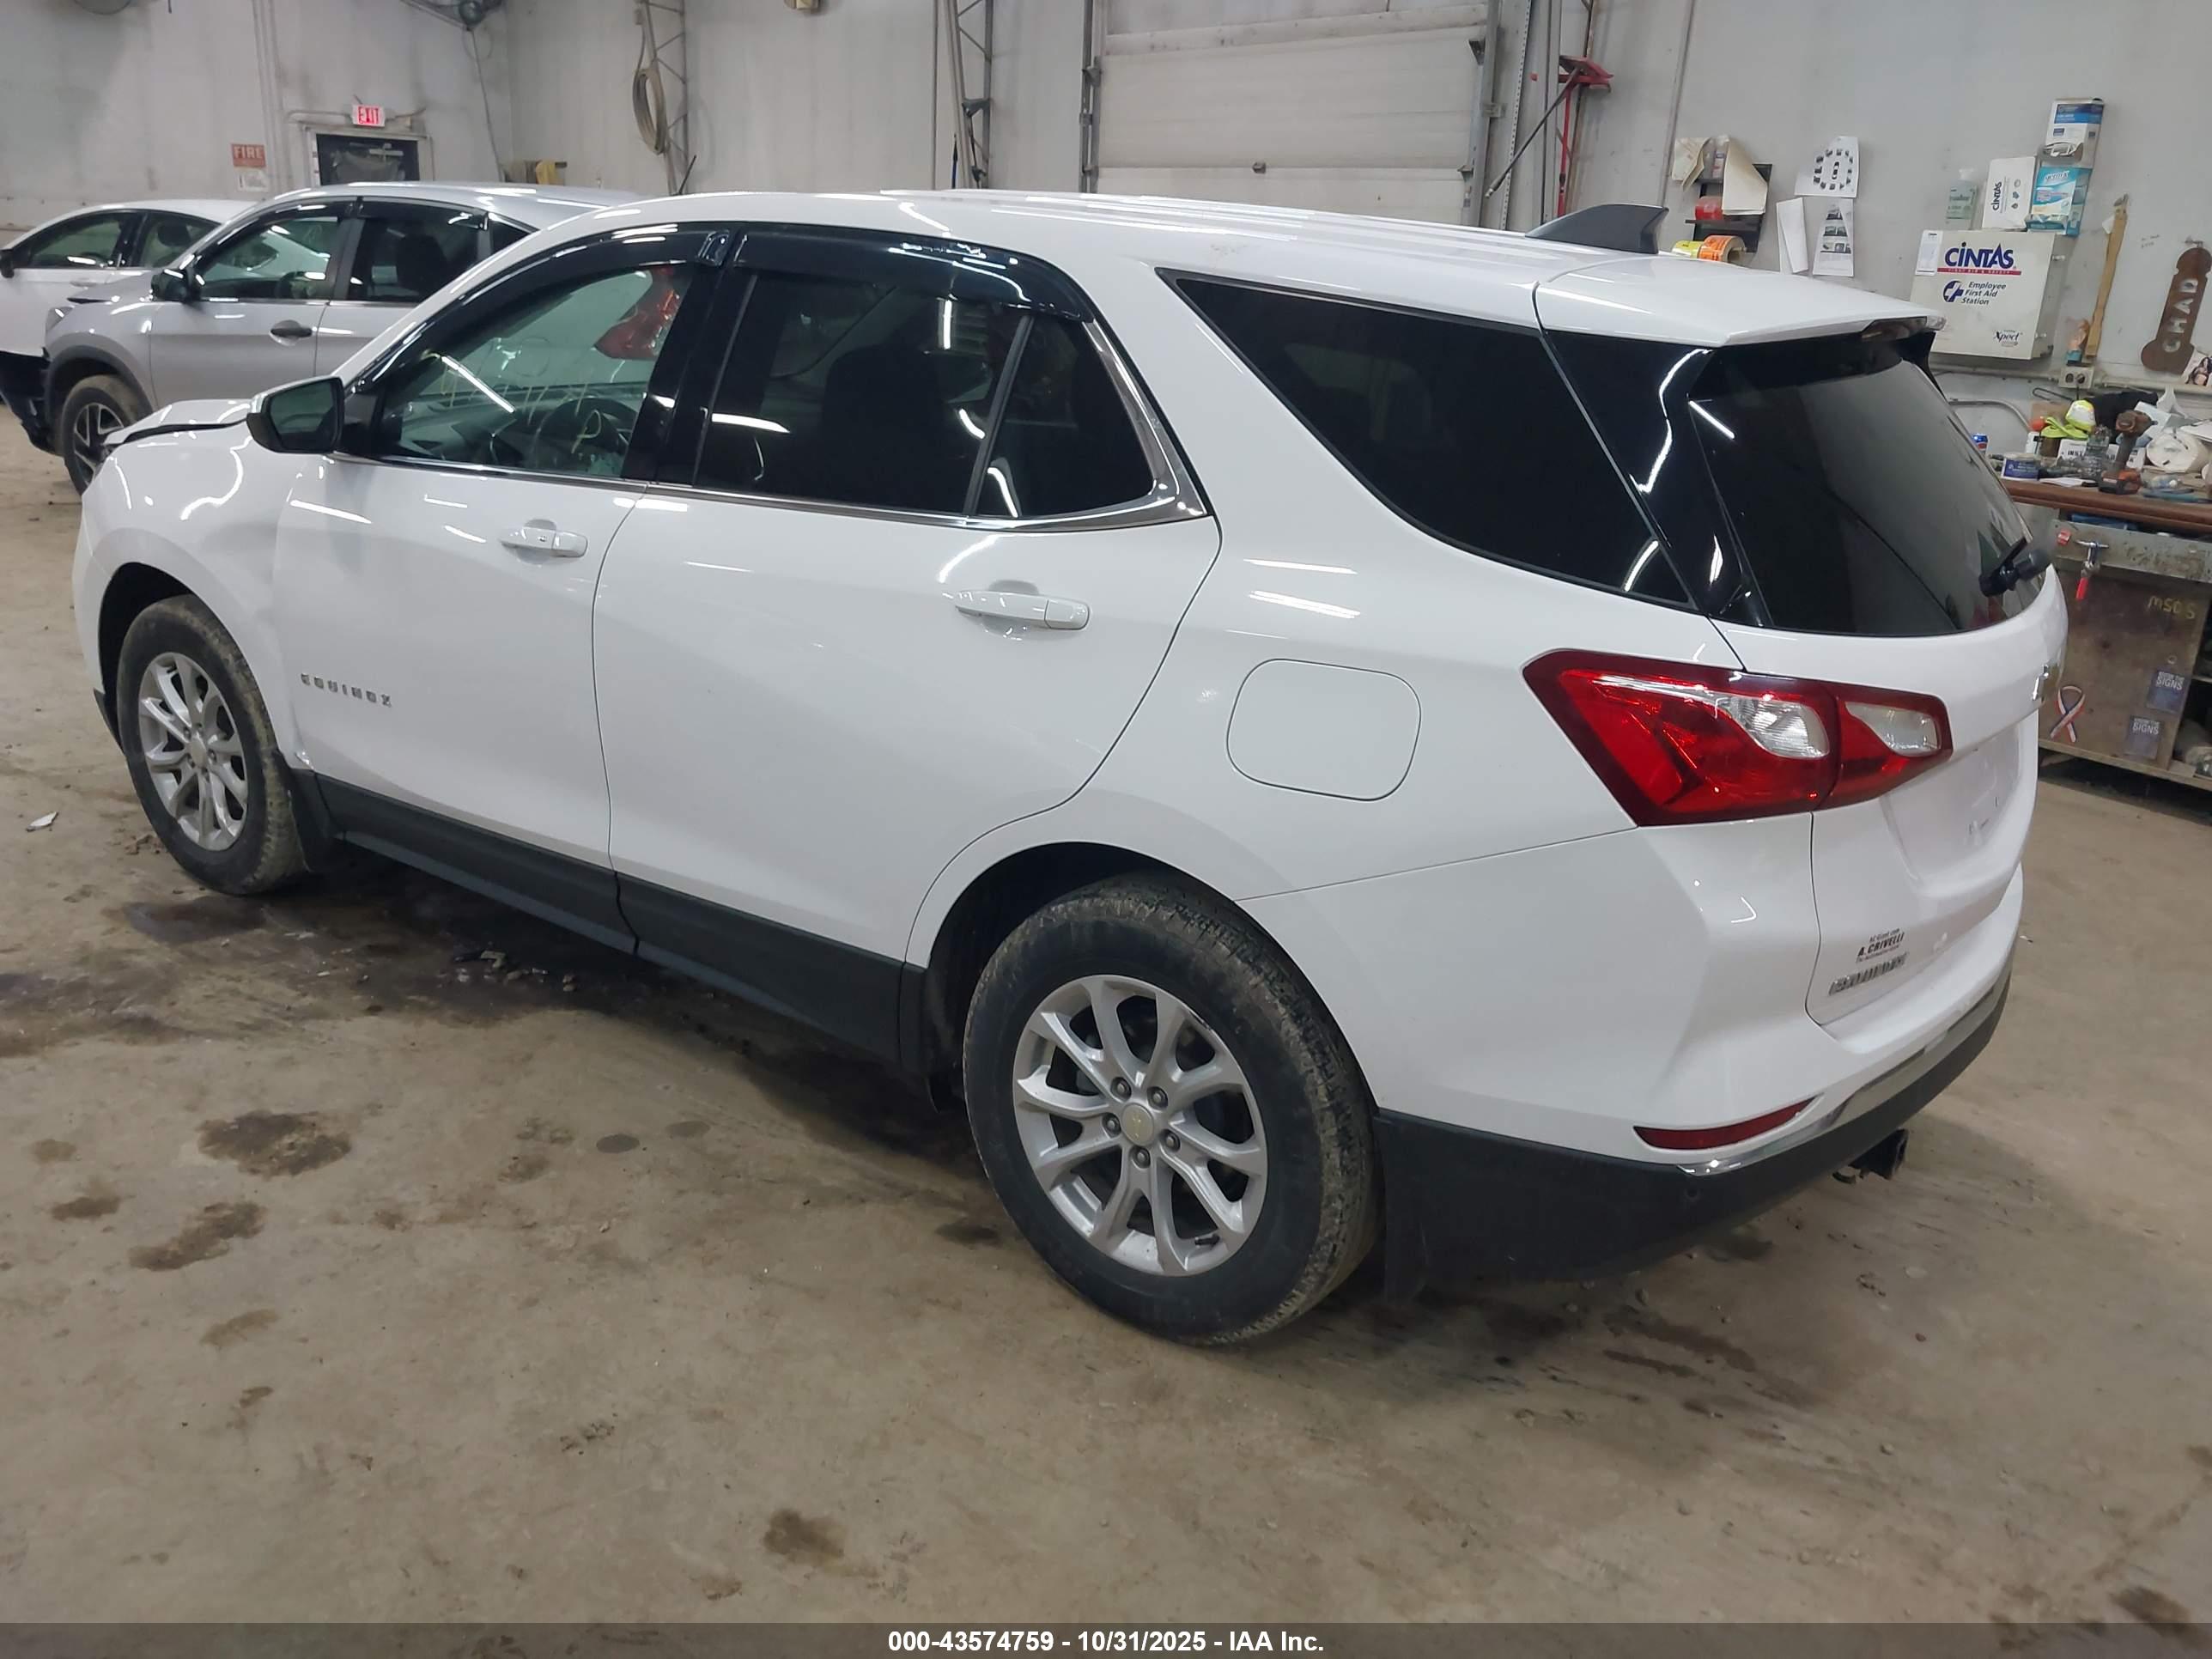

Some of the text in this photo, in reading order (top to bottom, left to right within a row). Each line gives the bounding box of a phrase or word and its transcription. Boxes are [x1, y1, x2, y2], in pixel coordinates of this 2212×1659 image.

[357, 106, 380, 125] EXIT
[234, 145, 264, 160] FIRE
[1990, 181, 2002, 211] CINTAS
[1944, 241, 2014, 270] CINTAS
[1968, 281, 2007, 290] Employee
[1961, 296, 1990, 305] Station
[2162, 278, 2199, 353] CHAD
[301, 672, 392, 708] EQUINOX
[2156, 676, 2183, 690] SIGNS
